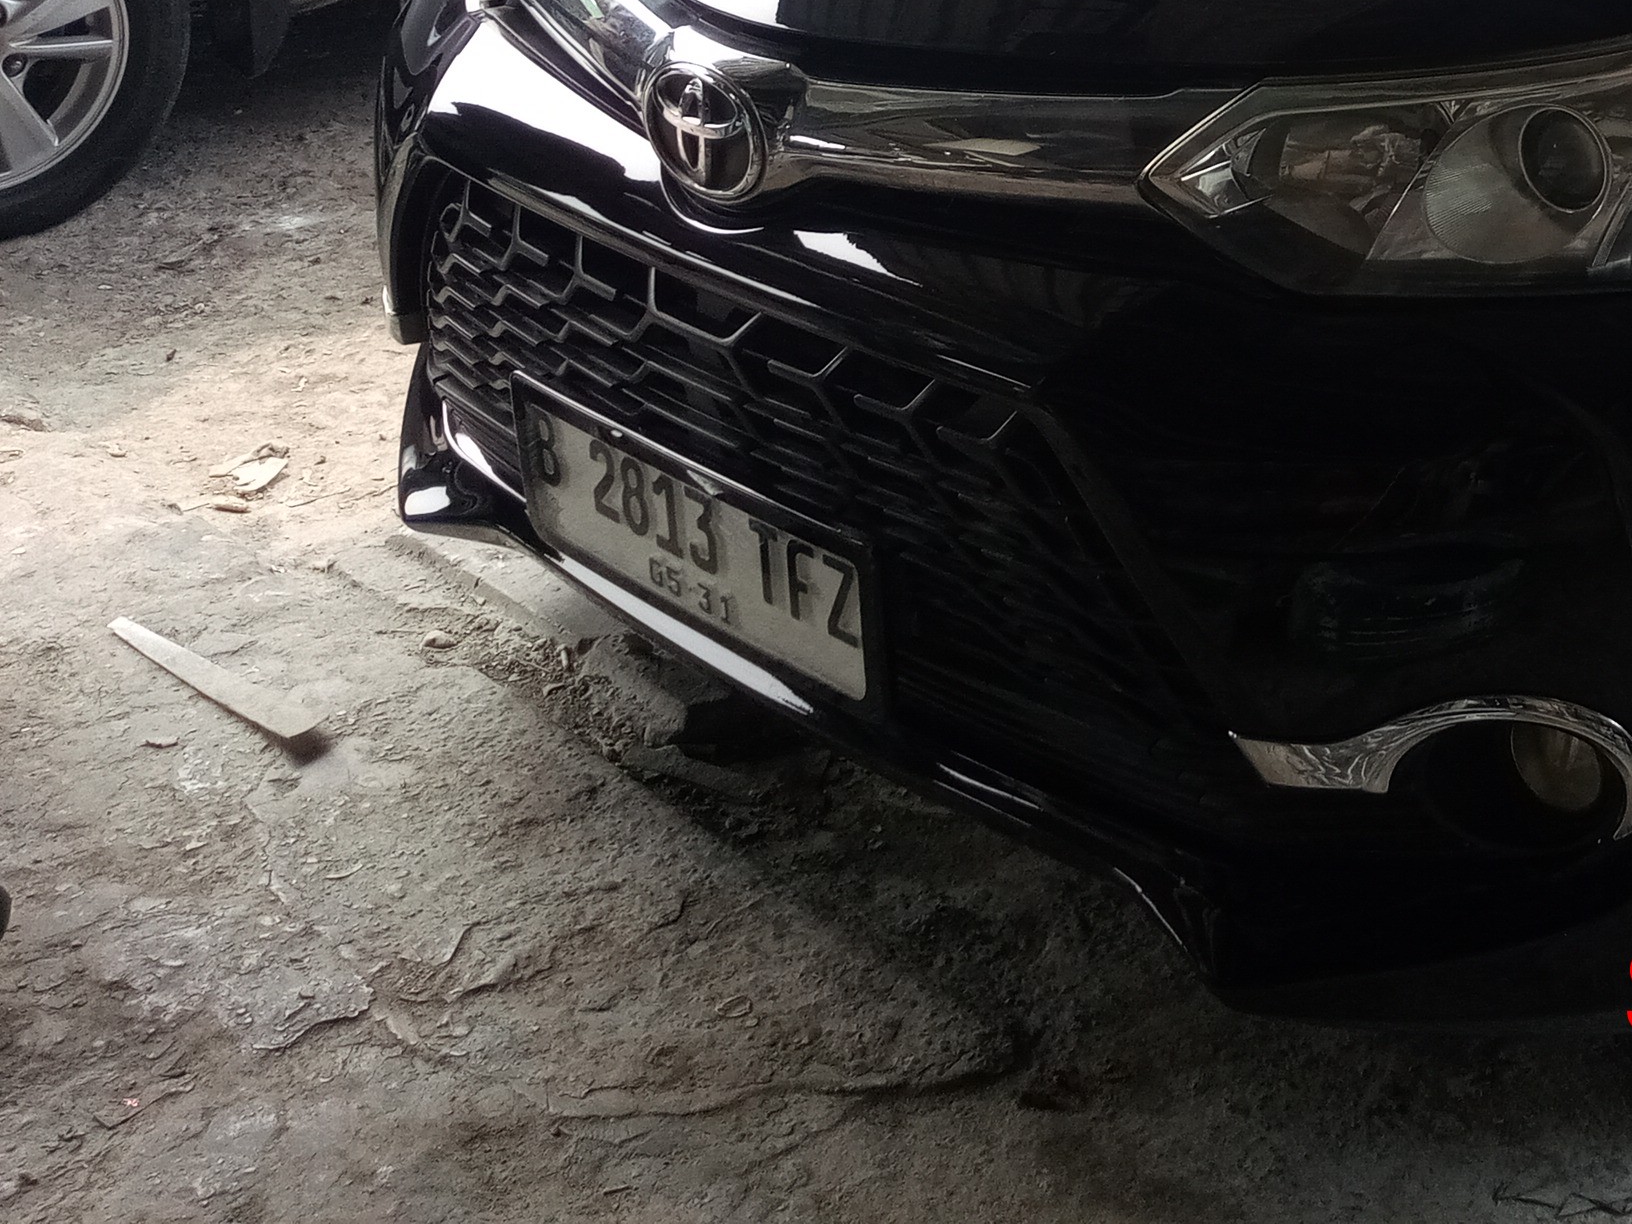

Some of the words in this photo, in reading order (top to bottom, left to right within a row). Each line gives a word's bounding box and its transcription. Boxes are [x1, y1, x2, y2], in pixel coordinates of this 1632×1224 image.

[535, 415, 563, 488] B
[588, 438, 719, 576] 2813
[748, 516, 861, 651] TFZ
